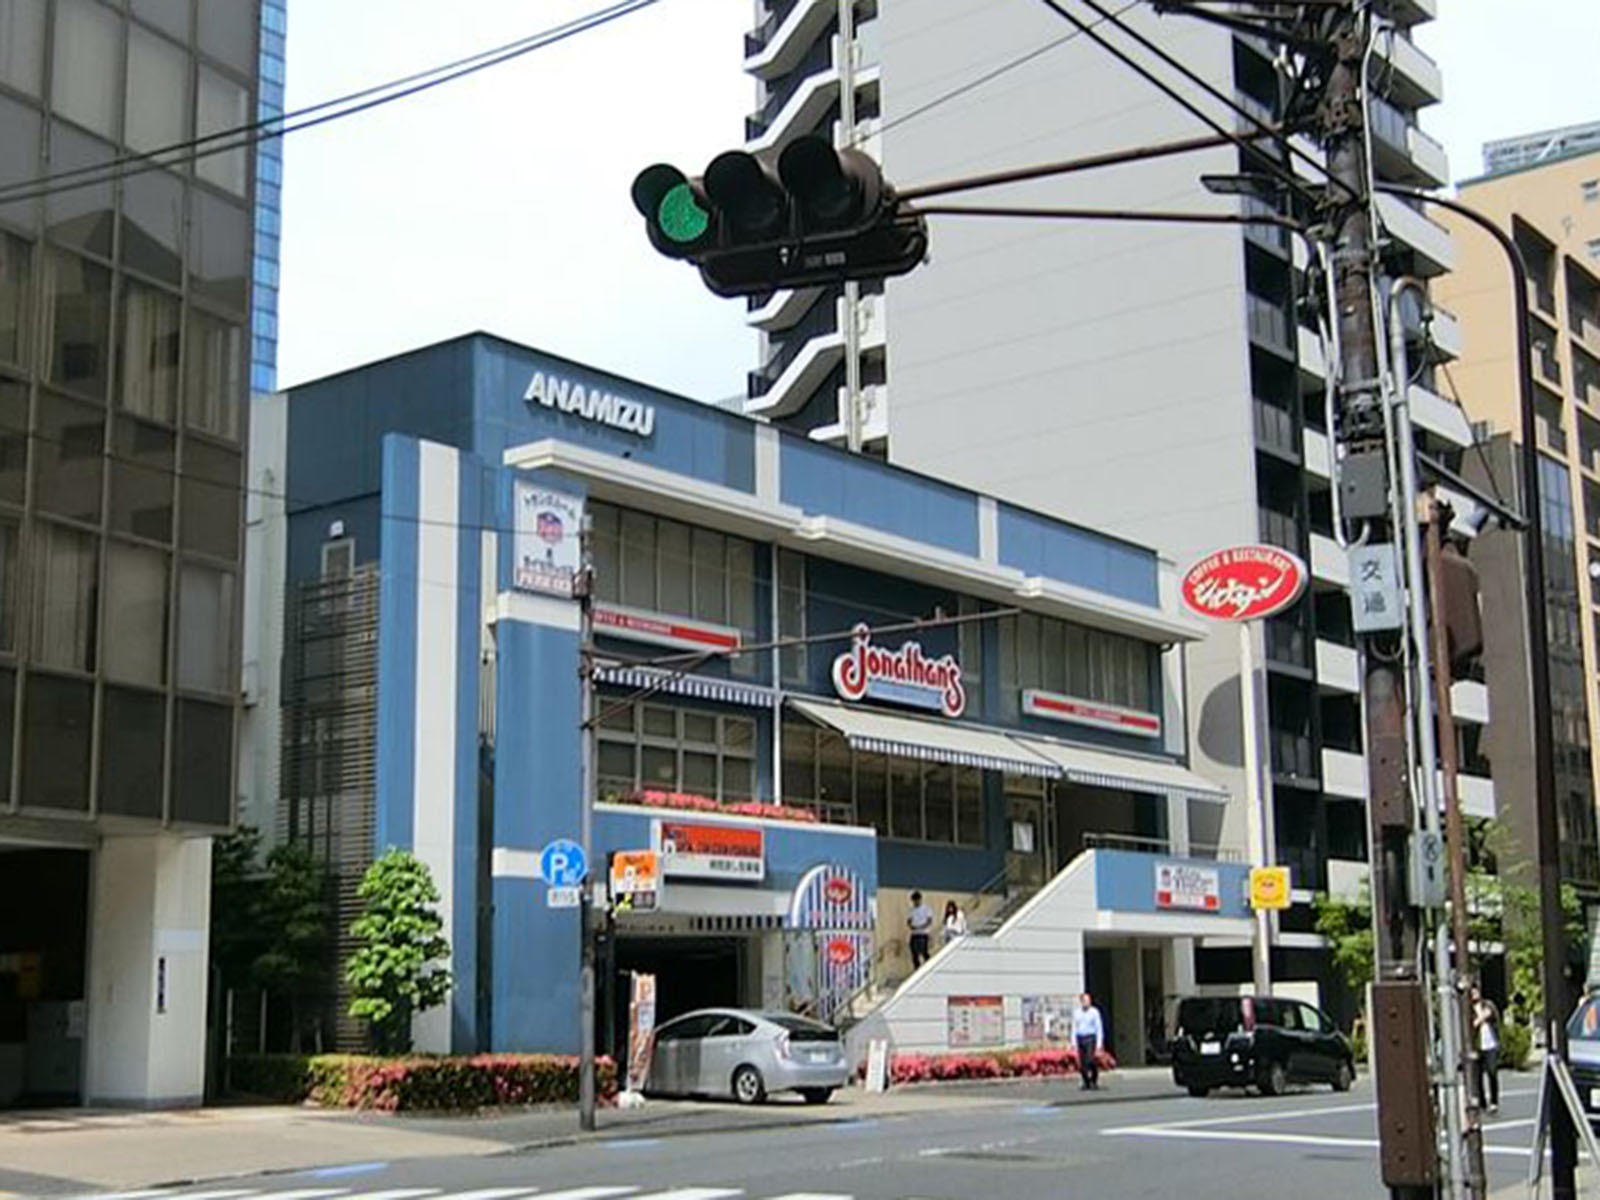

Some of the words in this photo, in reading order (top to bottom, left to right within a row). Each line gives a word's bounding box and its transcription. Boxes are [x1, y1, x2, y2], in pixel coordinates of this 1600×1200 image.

[523, 371, 655, 436] ANAMIZU
[833, 623, 964, 715] Jonathan's
[550, 853, 569, 887] P
